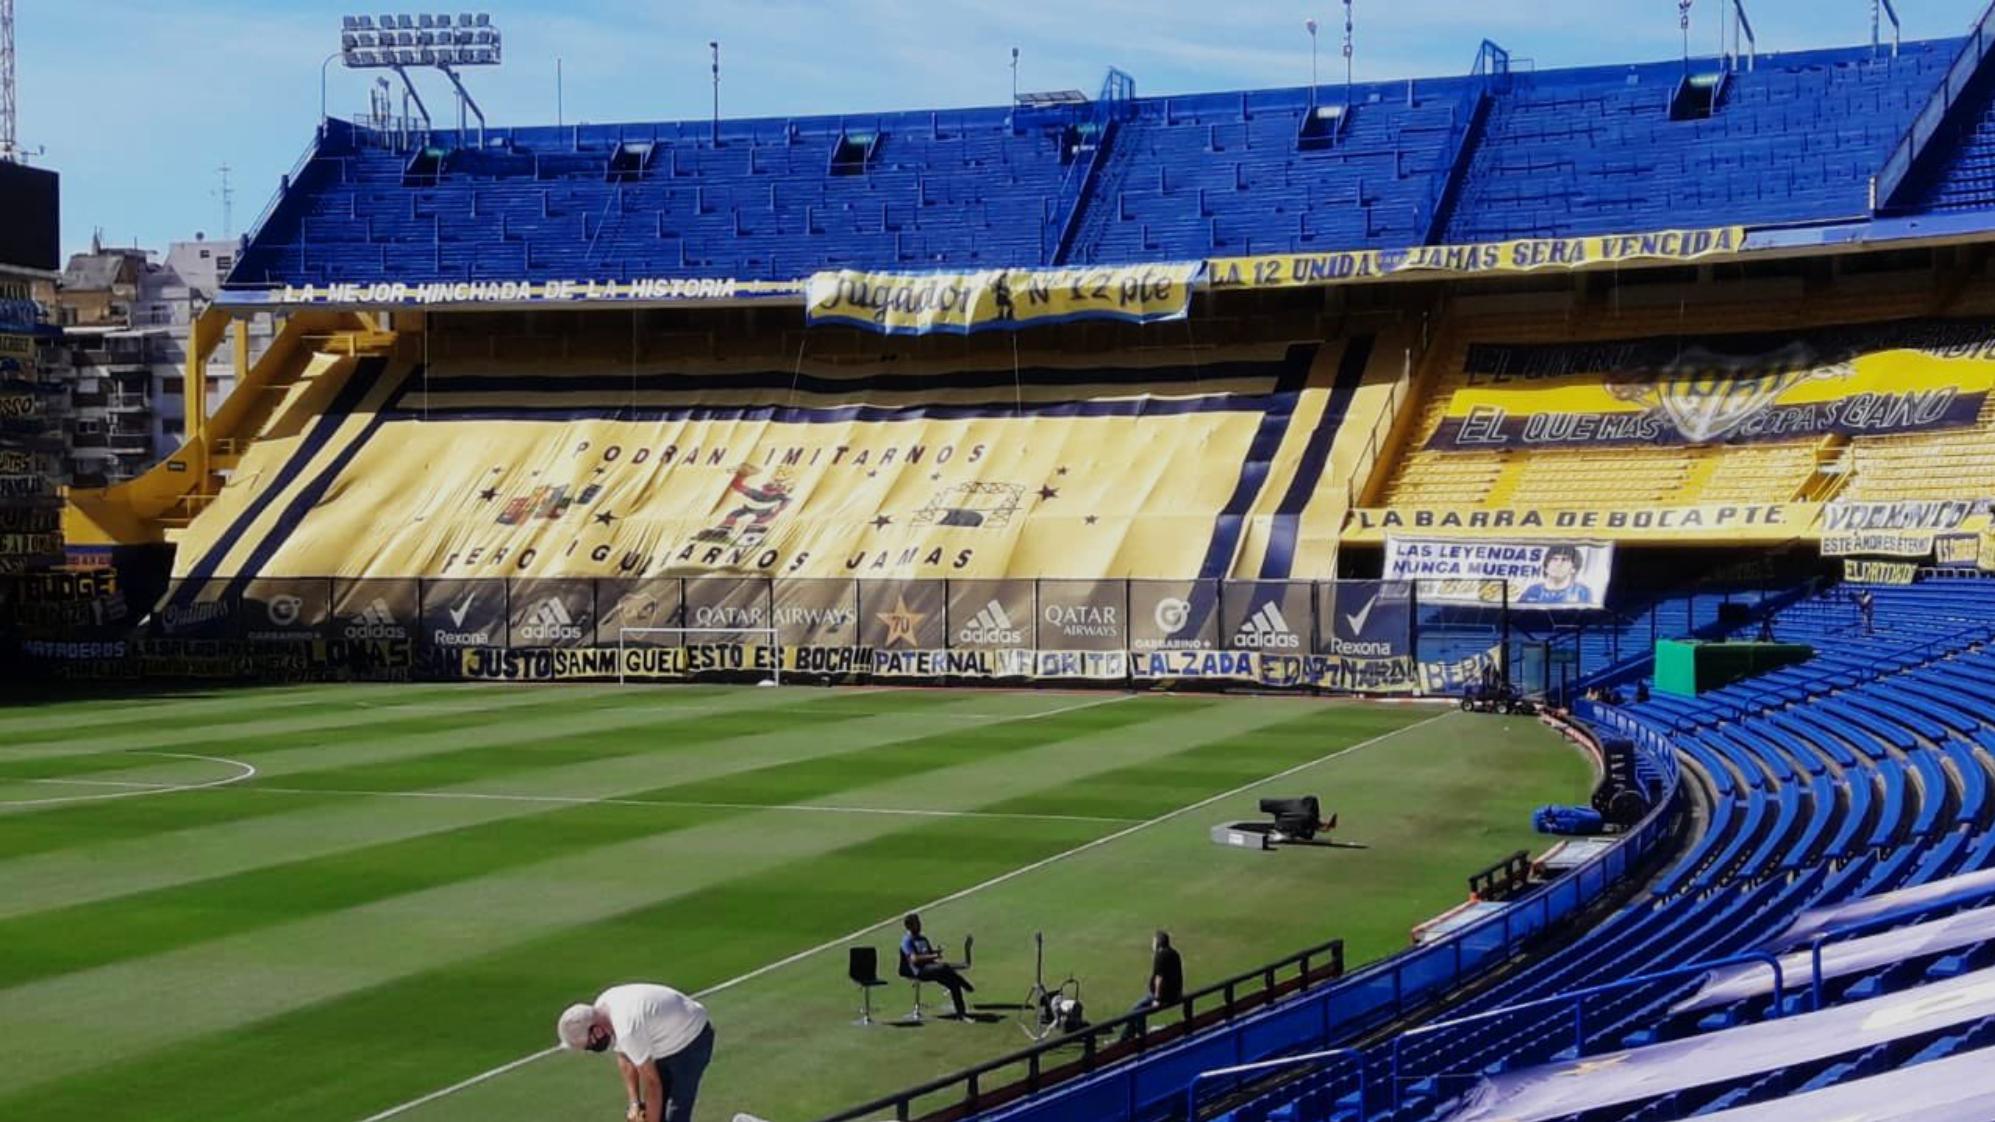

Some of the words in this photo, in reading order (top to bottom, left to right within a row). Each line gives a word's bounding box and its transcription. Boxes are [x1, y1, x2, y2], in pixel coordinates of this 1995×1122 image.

[1208, 265, 1241, 287] LA
[1253, 261, 1280, 284] 12
[1291, 255, 1371, 283] UNIDA
[1408, 245, 1499, 271] JAMAS
[1512, 238, 1585, 267] SERA
[1599, 228, 1733, 261] VENCIDA
[282, 283, 315, 302] LA
[326, 282, 407, 303] MEJOR
[416, 281, 531, 303] HINCHADA
[543, 280, 576, 299] DE
[585, 279, 617, 299] LA
[629, 277, 737, 298] HISTORIA
[814, 275, 973, 322] Jugador
[1119, 273, 1172, 307] pte
[1455, 403, 1510, 445] EL
[1521, 412, 1600, 443] QUE
[1597, 412, 1662, 441] MAS
[1840, 385, 1958, 428] GANO
[576, 441, 727, 466] PODRAN
[764, 444, 986, 467] IMITARNOS
[1361, 510, 1404, 529] LA
[1415, 509, 1543, 528] BARRA
[1555, 511, 1599, 528] DE
[1606, 507, 1701, 529] BOCA
[846, 547, 975, 570] JAMAS
[1396, 545, 1433, 557] LAS
[1439, 545, 1543, 562] LEYENDAS
[1392, 559, 1461, 575] NUNCA
[1466, 561, 1543, 578] MUEREN
[695, 607, 763, 625] QATAR
[772, 606, 856, 626] AIRWAYS
[1044, 604, 1118, 624] QATAR
[344, 624, 406, 639] adidas
[434, 629, 489, 646] Rexona
[520, 624, 582, 640] adidas
[959, 628, 1022, 644] adidas
[1063, 625, 1119, 637] AIRWAYS
[1233, 629, 1300, 649] adidas
[687, 645, 743, 669] ESTO
[1330, 638, 1391, 656] Rexona
[874, 650, 992, 676] PATERNAL
[1130, 652, 1252, 676] CALZADA
